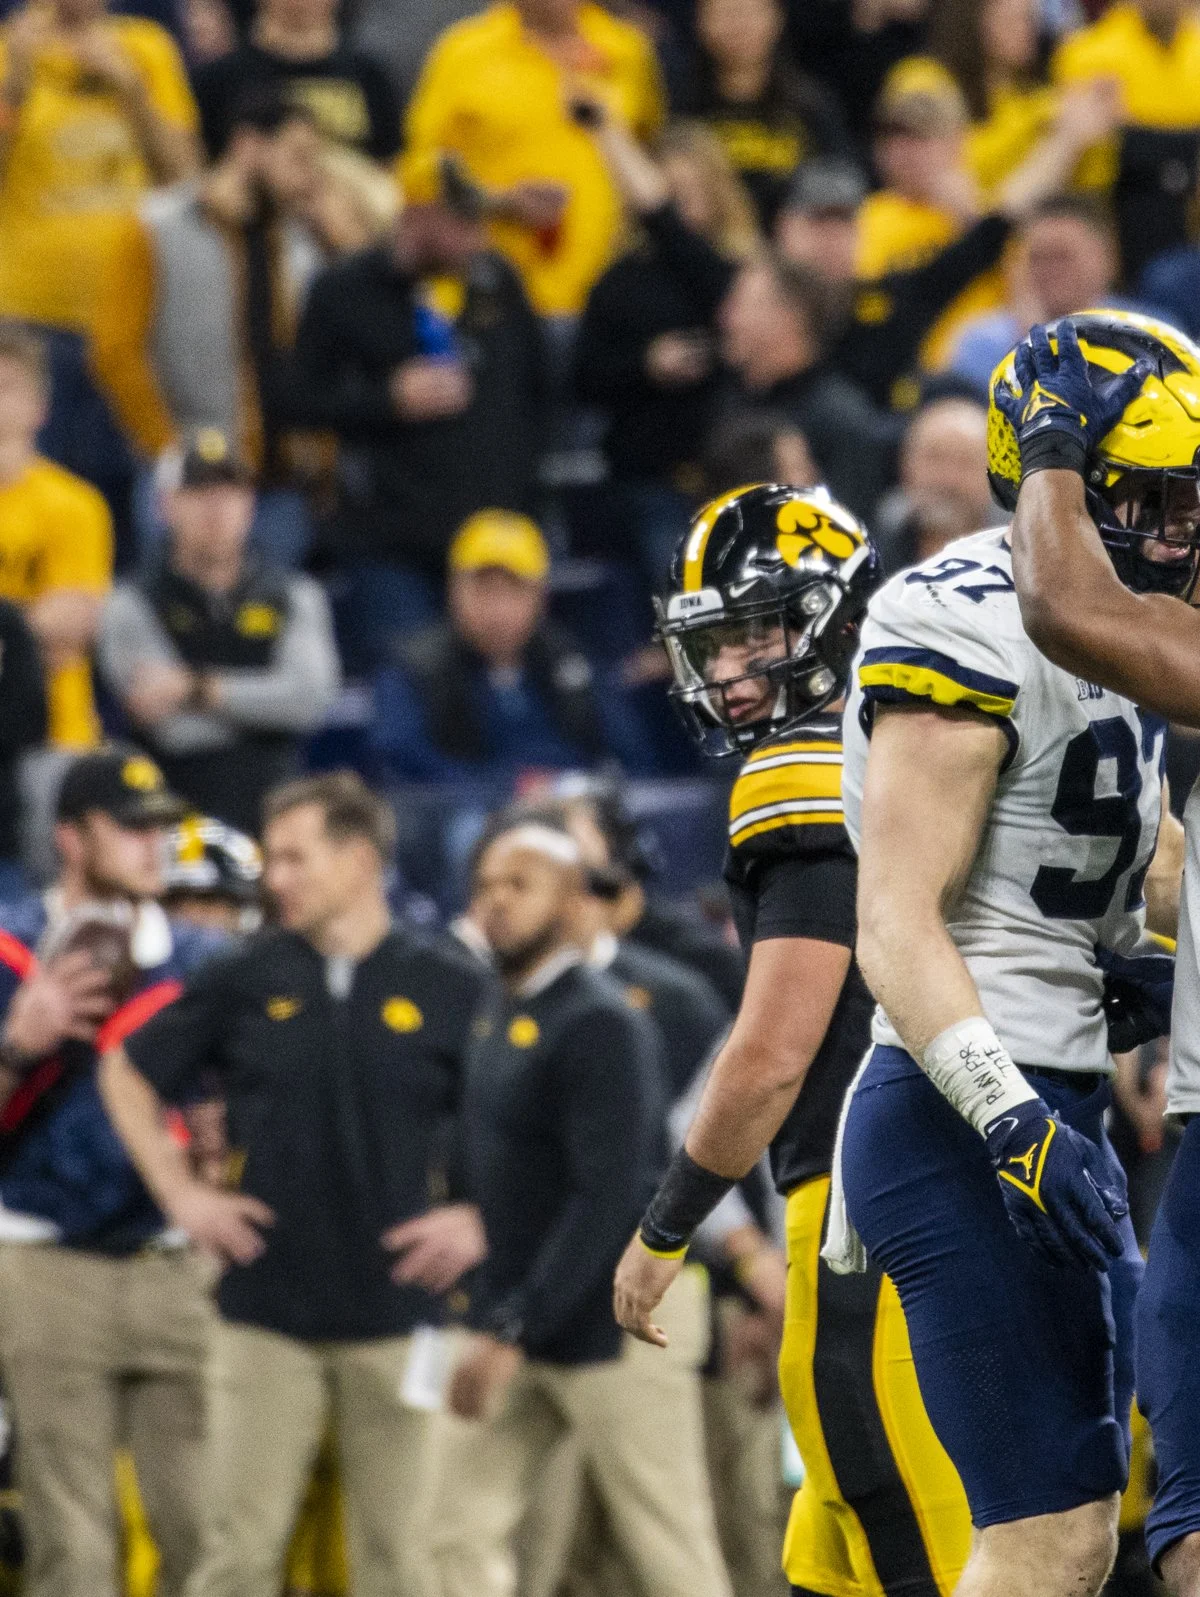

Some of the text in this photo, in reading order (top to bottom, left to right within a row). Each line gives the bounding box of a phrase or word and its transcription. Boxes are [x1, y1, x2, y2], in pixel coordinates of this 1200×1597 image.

[680, 596, 704, 609] IOWA
[959, 1041, 1006, 1106] PLAY FOR
